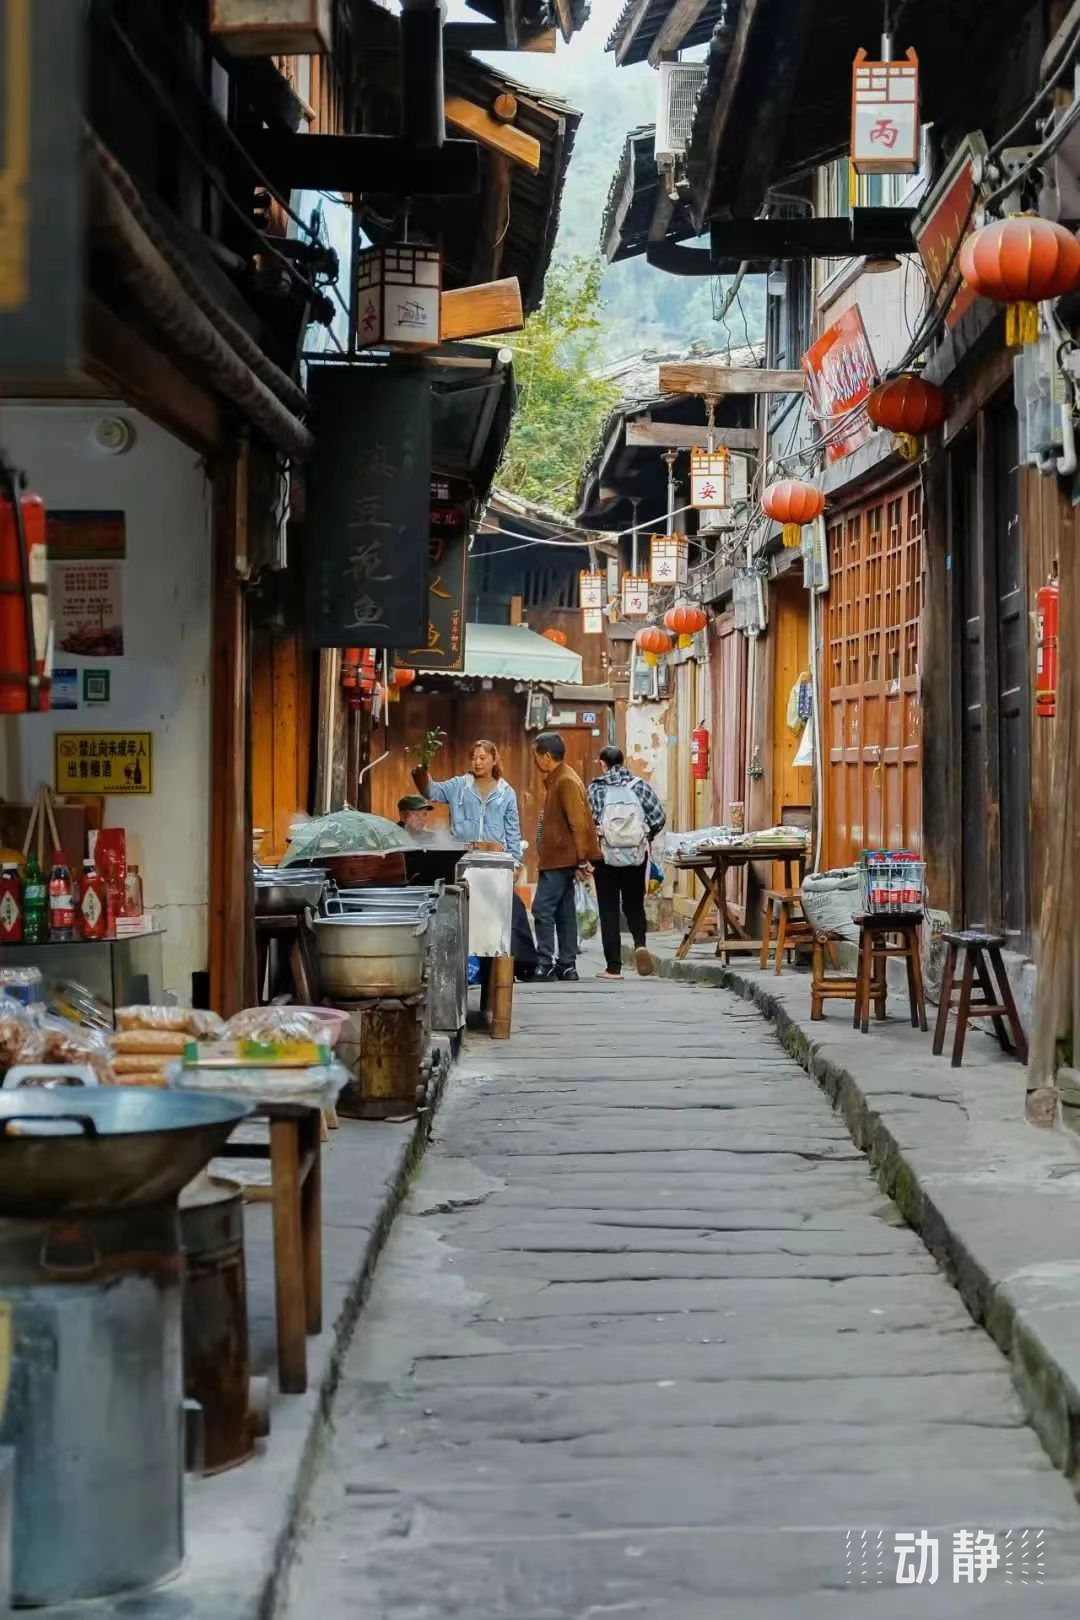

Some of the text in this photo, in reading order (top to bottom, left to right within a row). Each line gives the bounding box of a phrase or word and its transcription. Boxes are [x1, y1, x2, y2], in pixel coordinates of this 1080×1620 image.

[870, 119, 898, 148] 丙
[362, 296, 377, 332] 安
[698, 481, 717, 500] 安
[342, 441, 400, 629] 豆花鱼
[657, 561, 672, 577] 安
[630, 598, 642, 610] 丙
[80, 739, 146, 757] 禁止向未成年人
[68, 760, 112, 778] 出售烟酒
